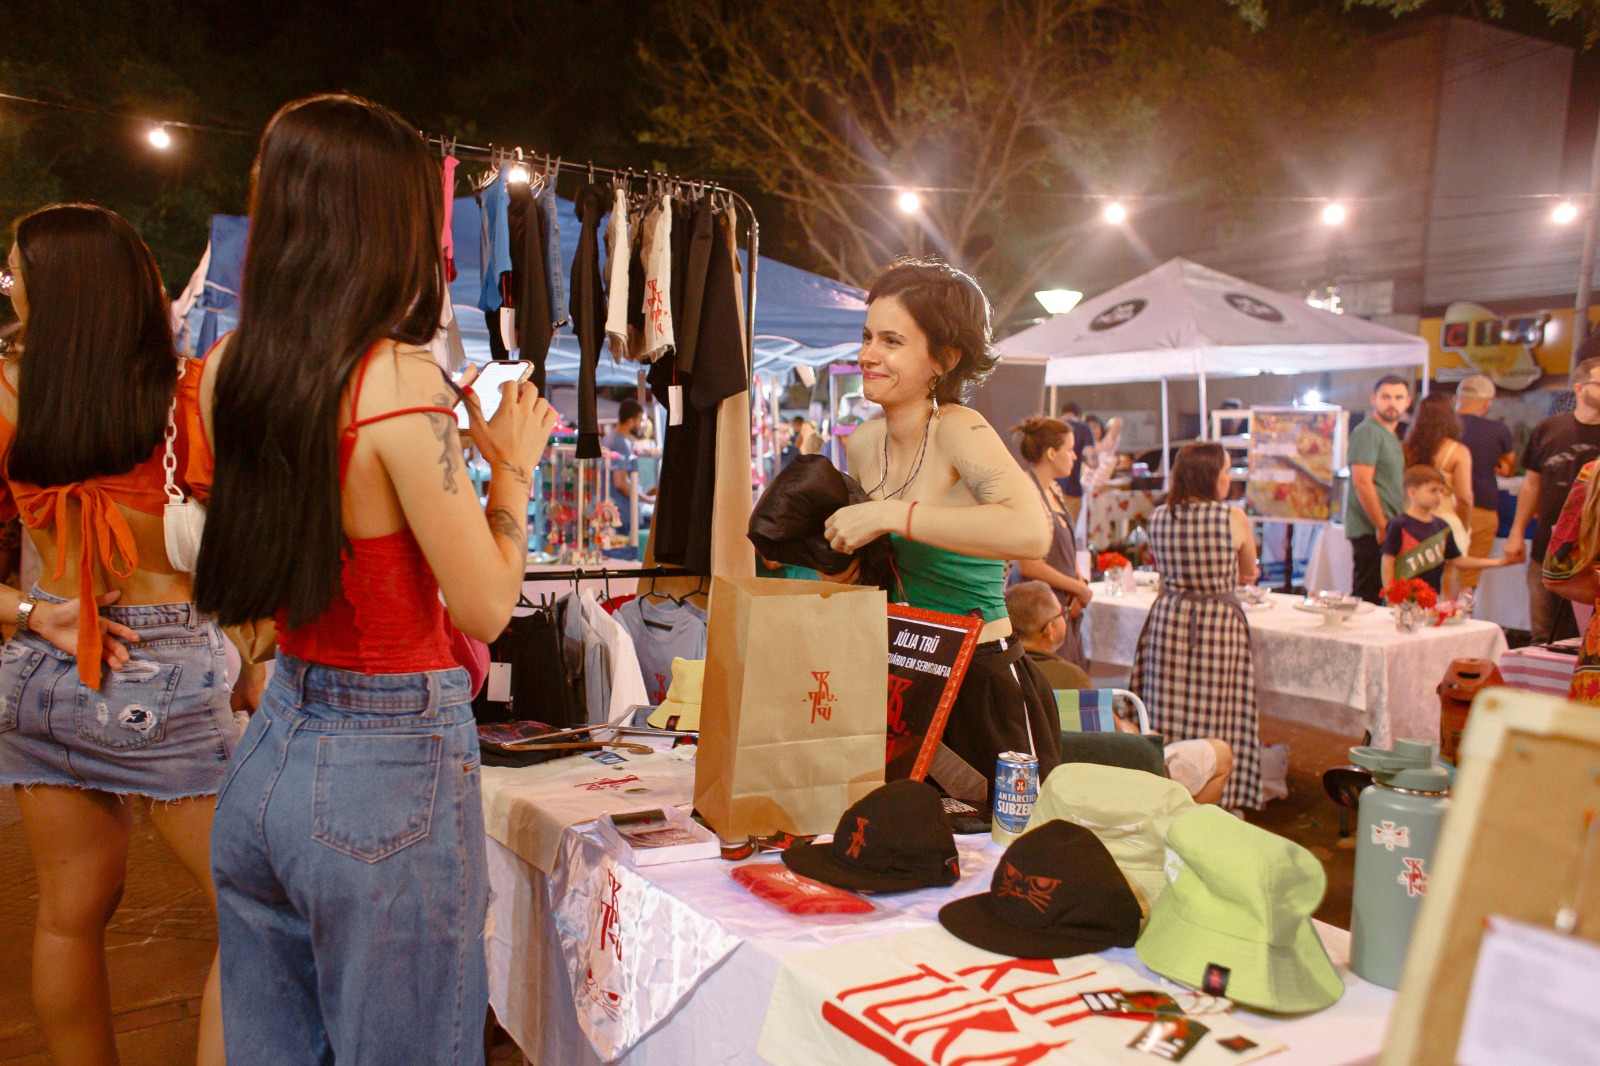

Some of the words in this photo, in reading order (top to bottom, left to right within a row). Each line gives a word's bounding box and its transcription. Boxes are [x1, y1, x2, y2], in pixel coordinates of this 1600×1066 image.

[893, 628, 920, 650] JÚLIA
[905, 657, 917, 670] EM
[915, 659, 952, 678] SERIGRAFIA
[997, 800, 1033, 816] SUBZER
